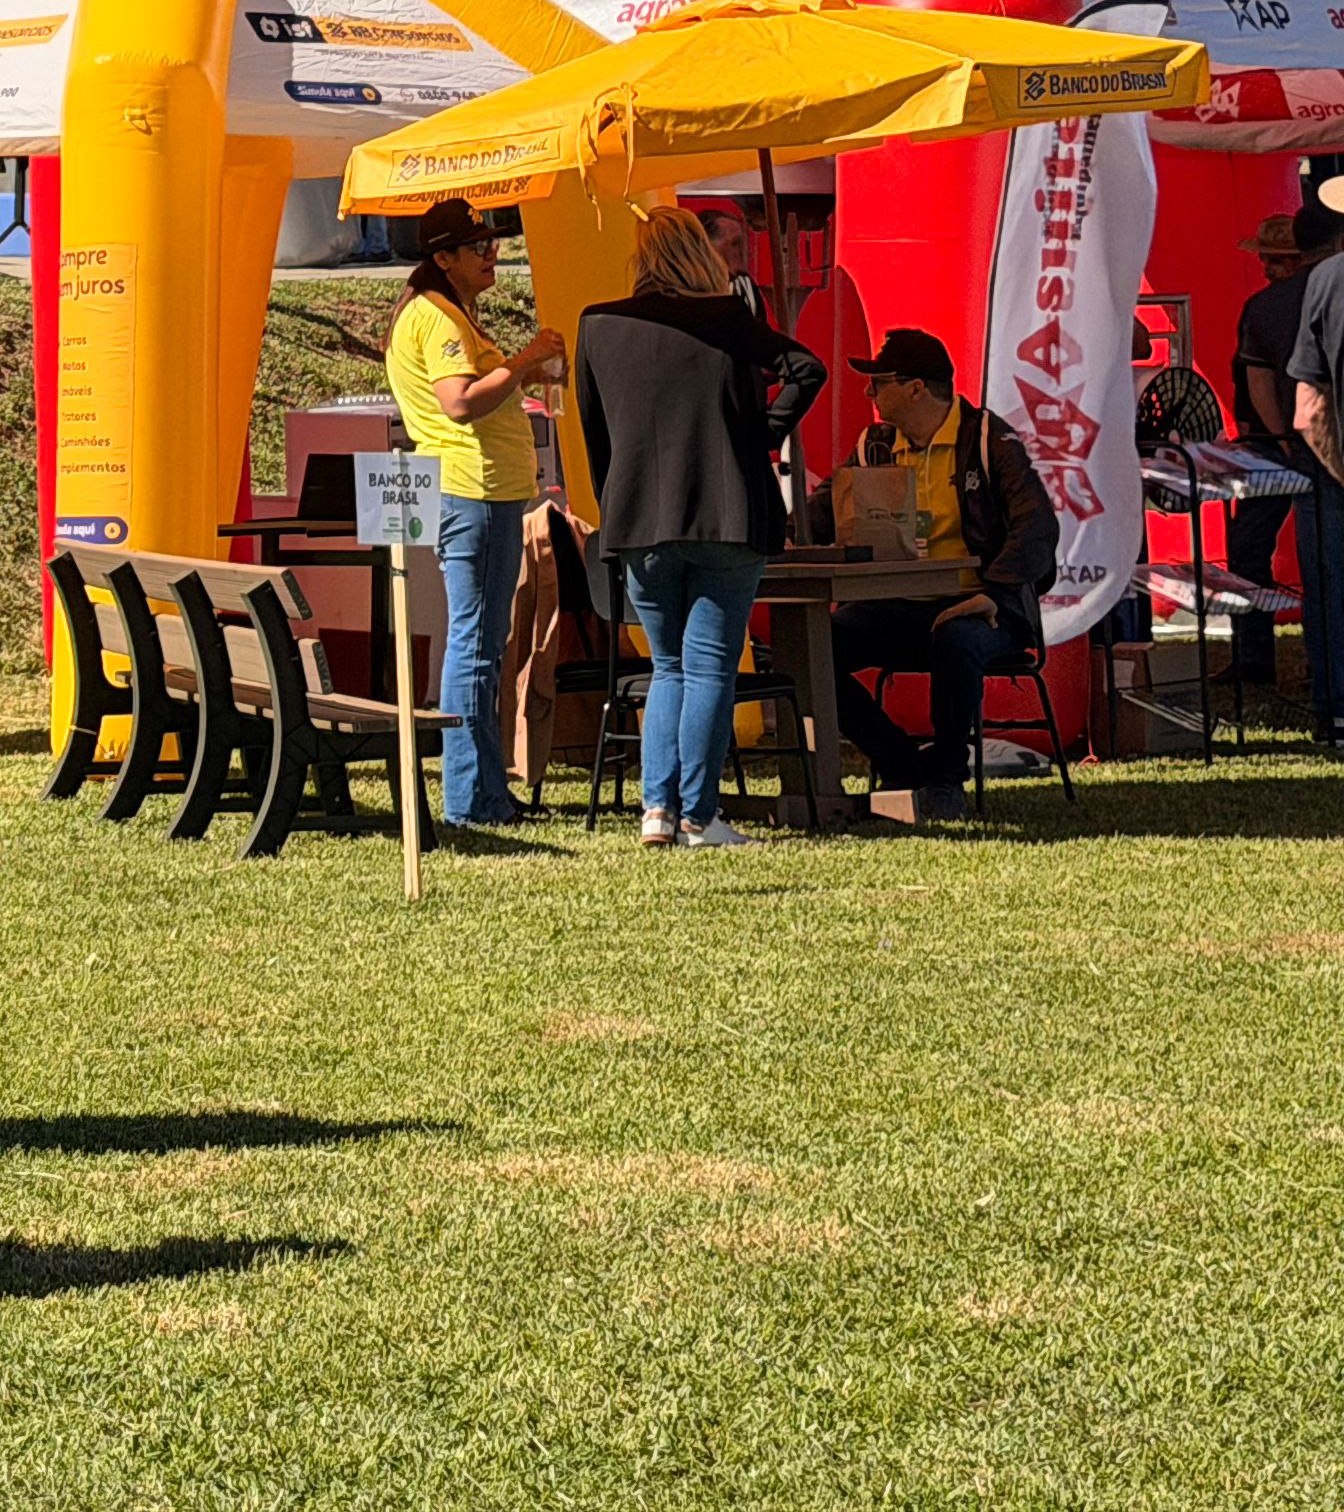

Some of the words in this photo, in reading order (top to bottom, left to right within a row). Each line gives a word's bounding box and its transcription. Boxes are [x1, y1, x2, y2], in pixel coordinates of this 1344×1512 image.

[1050, 74, 1098, 95] BANCO
[1100, 74, 1119, 93] DO
[424, 152, 478, 176] BANCO
[480, 149, 501, 168] DO
[74, 274, 125, 301] juros
[368, 472, 412, 488] BANCO
[414, 473, 432, 489] DO
[382, 490, 420, 506] BRASIL
